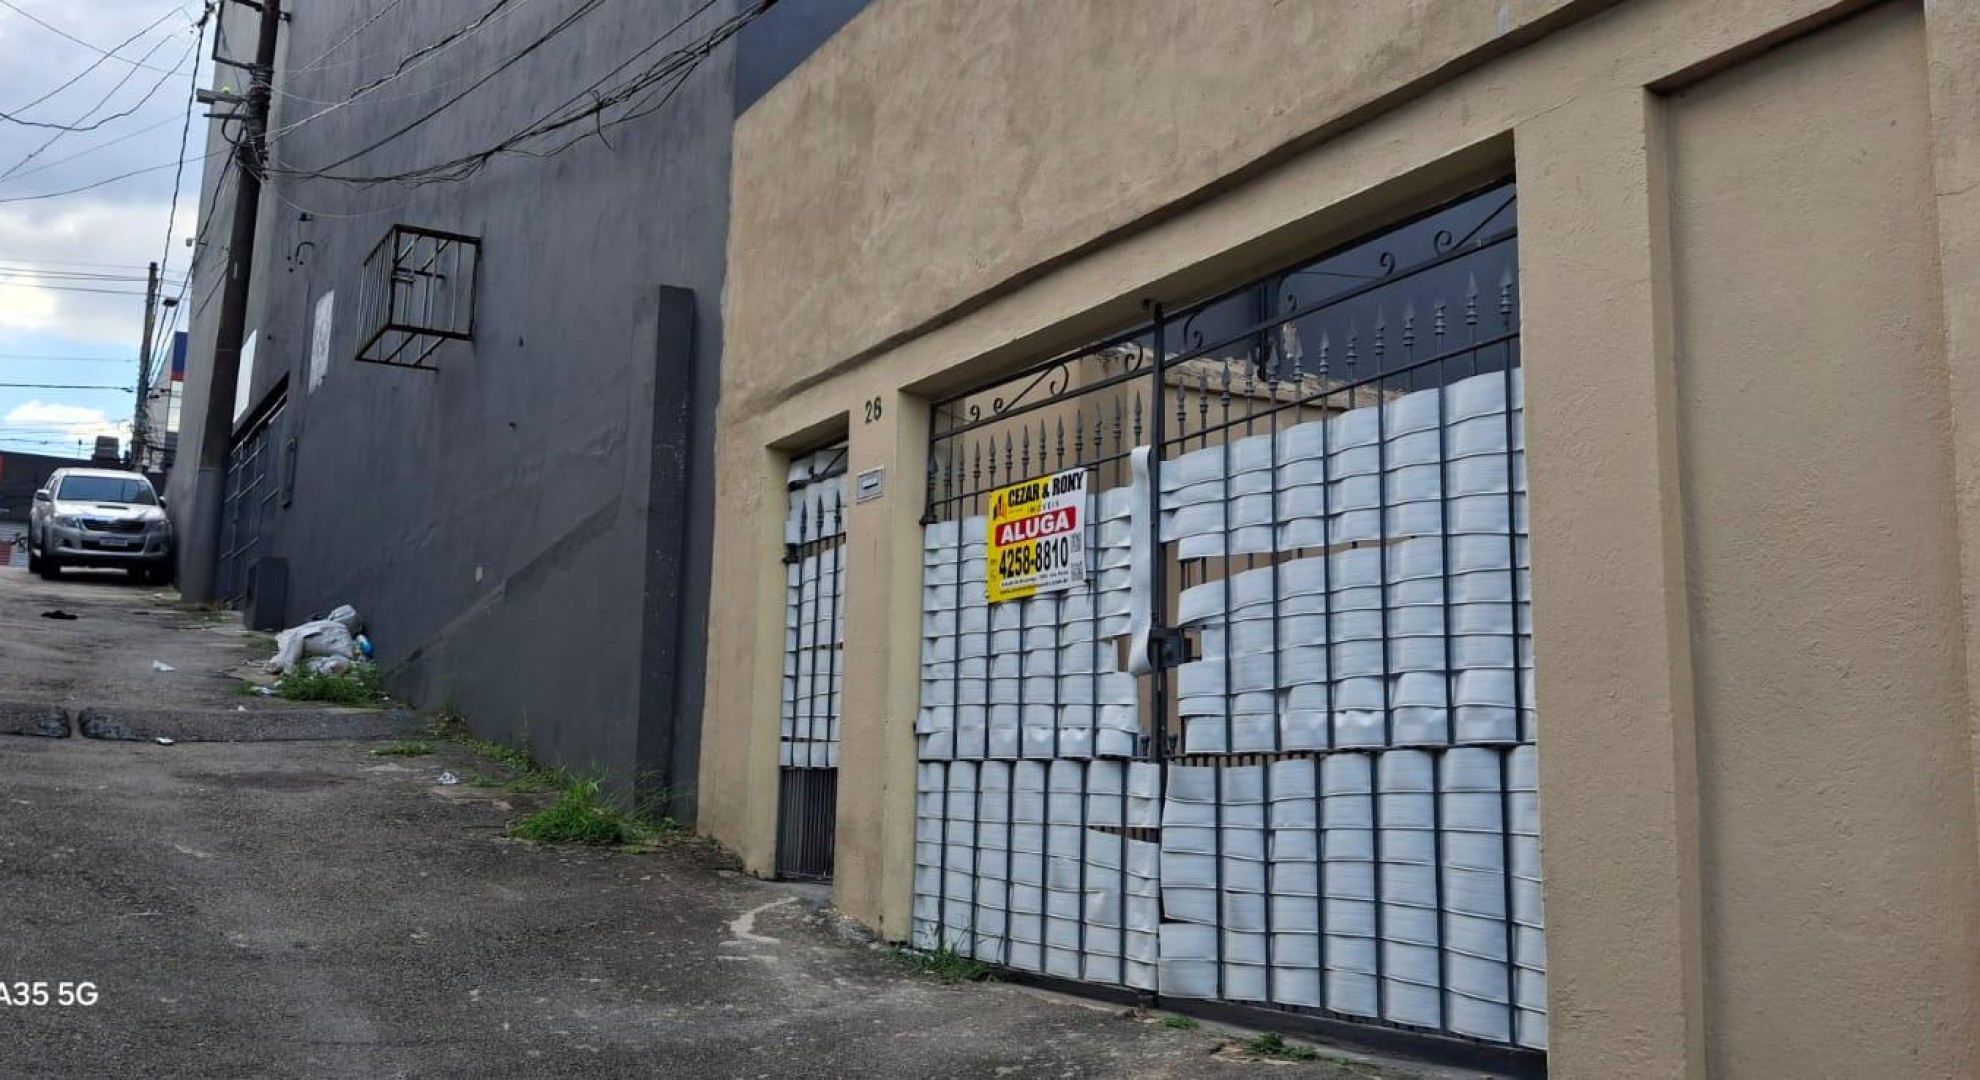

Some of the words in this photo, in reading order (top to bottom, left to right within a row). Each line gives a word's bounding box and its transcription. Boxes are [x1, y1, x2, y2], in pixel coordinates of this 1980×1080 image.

[865, 395, 882, 424] 26
[1008, 483, 1040, 507] CEZAR
[1042, 483, 1050, 499] &
[1052, 471, 1084, 496] RONY
[1001, 511, 1070, 544] ALUGA
[999, 537, 1069, 578] 4258-8810
